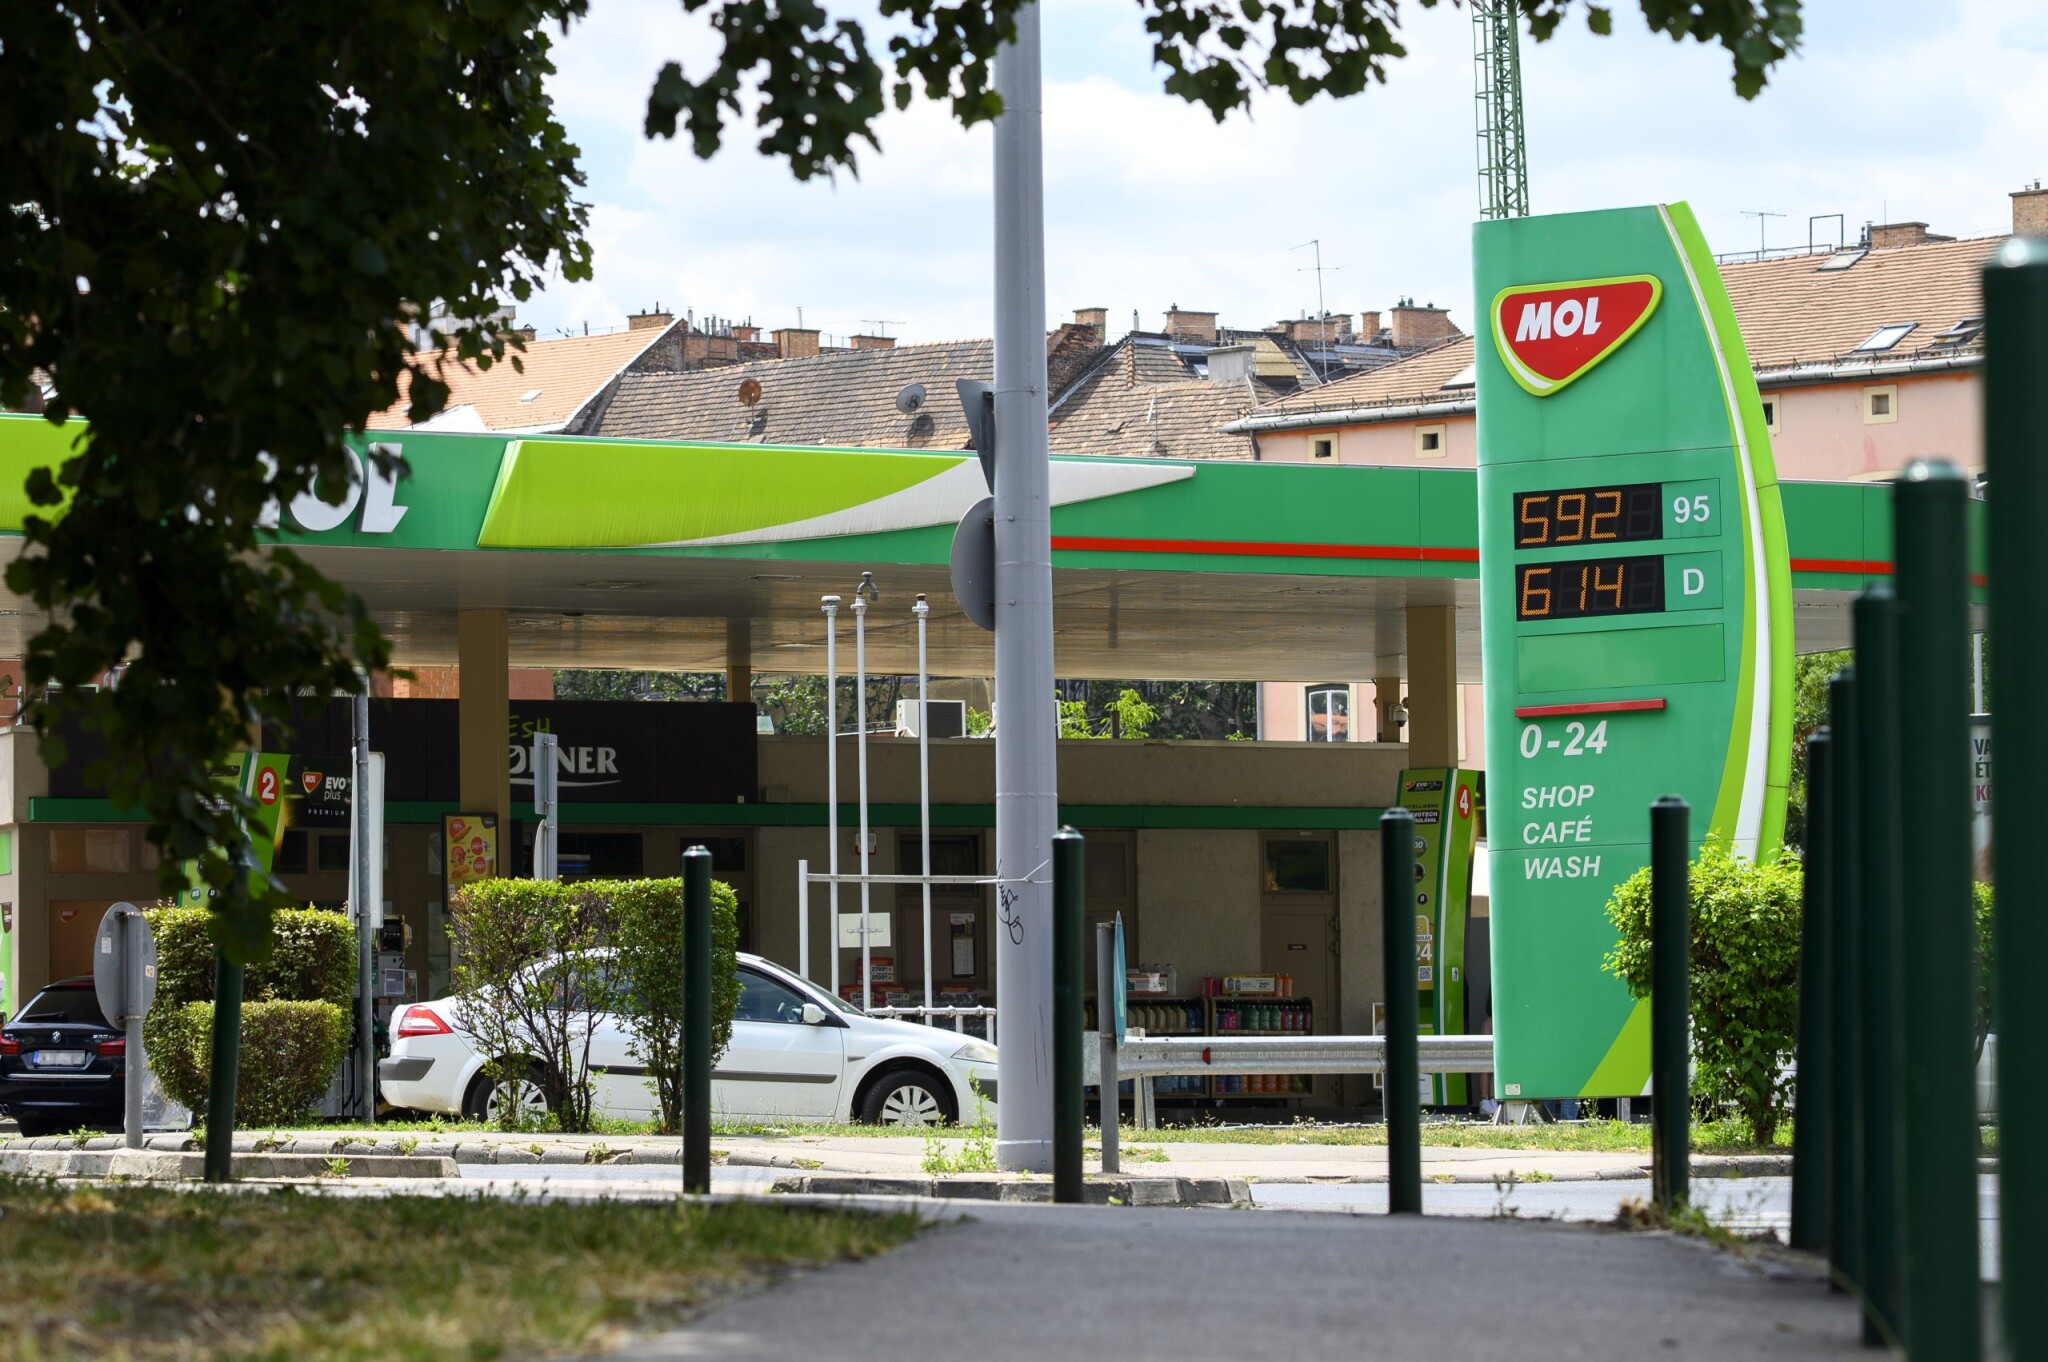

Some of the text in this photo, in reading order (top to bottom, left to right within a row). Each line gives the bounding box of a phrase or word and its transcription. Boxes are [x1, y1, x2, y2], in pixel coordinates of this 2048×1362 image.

[1515, 297, 1601, 342] MOL
[185, 441, 409, 533] OL
[1520, 491, 1710, 544] 592 95
[1521, 564, 1704, 616] 614 D
[509, 745, 618, 774] ONER
[261, 771, 275, 800] 2
[324, 788, 341, 802] plus
[325, 776, 346, 790] EVO
[1521, 785, 1595, 809] SHOP
[308, 808, 345, 816] PREMIUM
[1460, 789, 1469, 815] 4
[1523, 815, 1593, 844] CAFÉ
[1524, 855, 1601, 880] WASH
